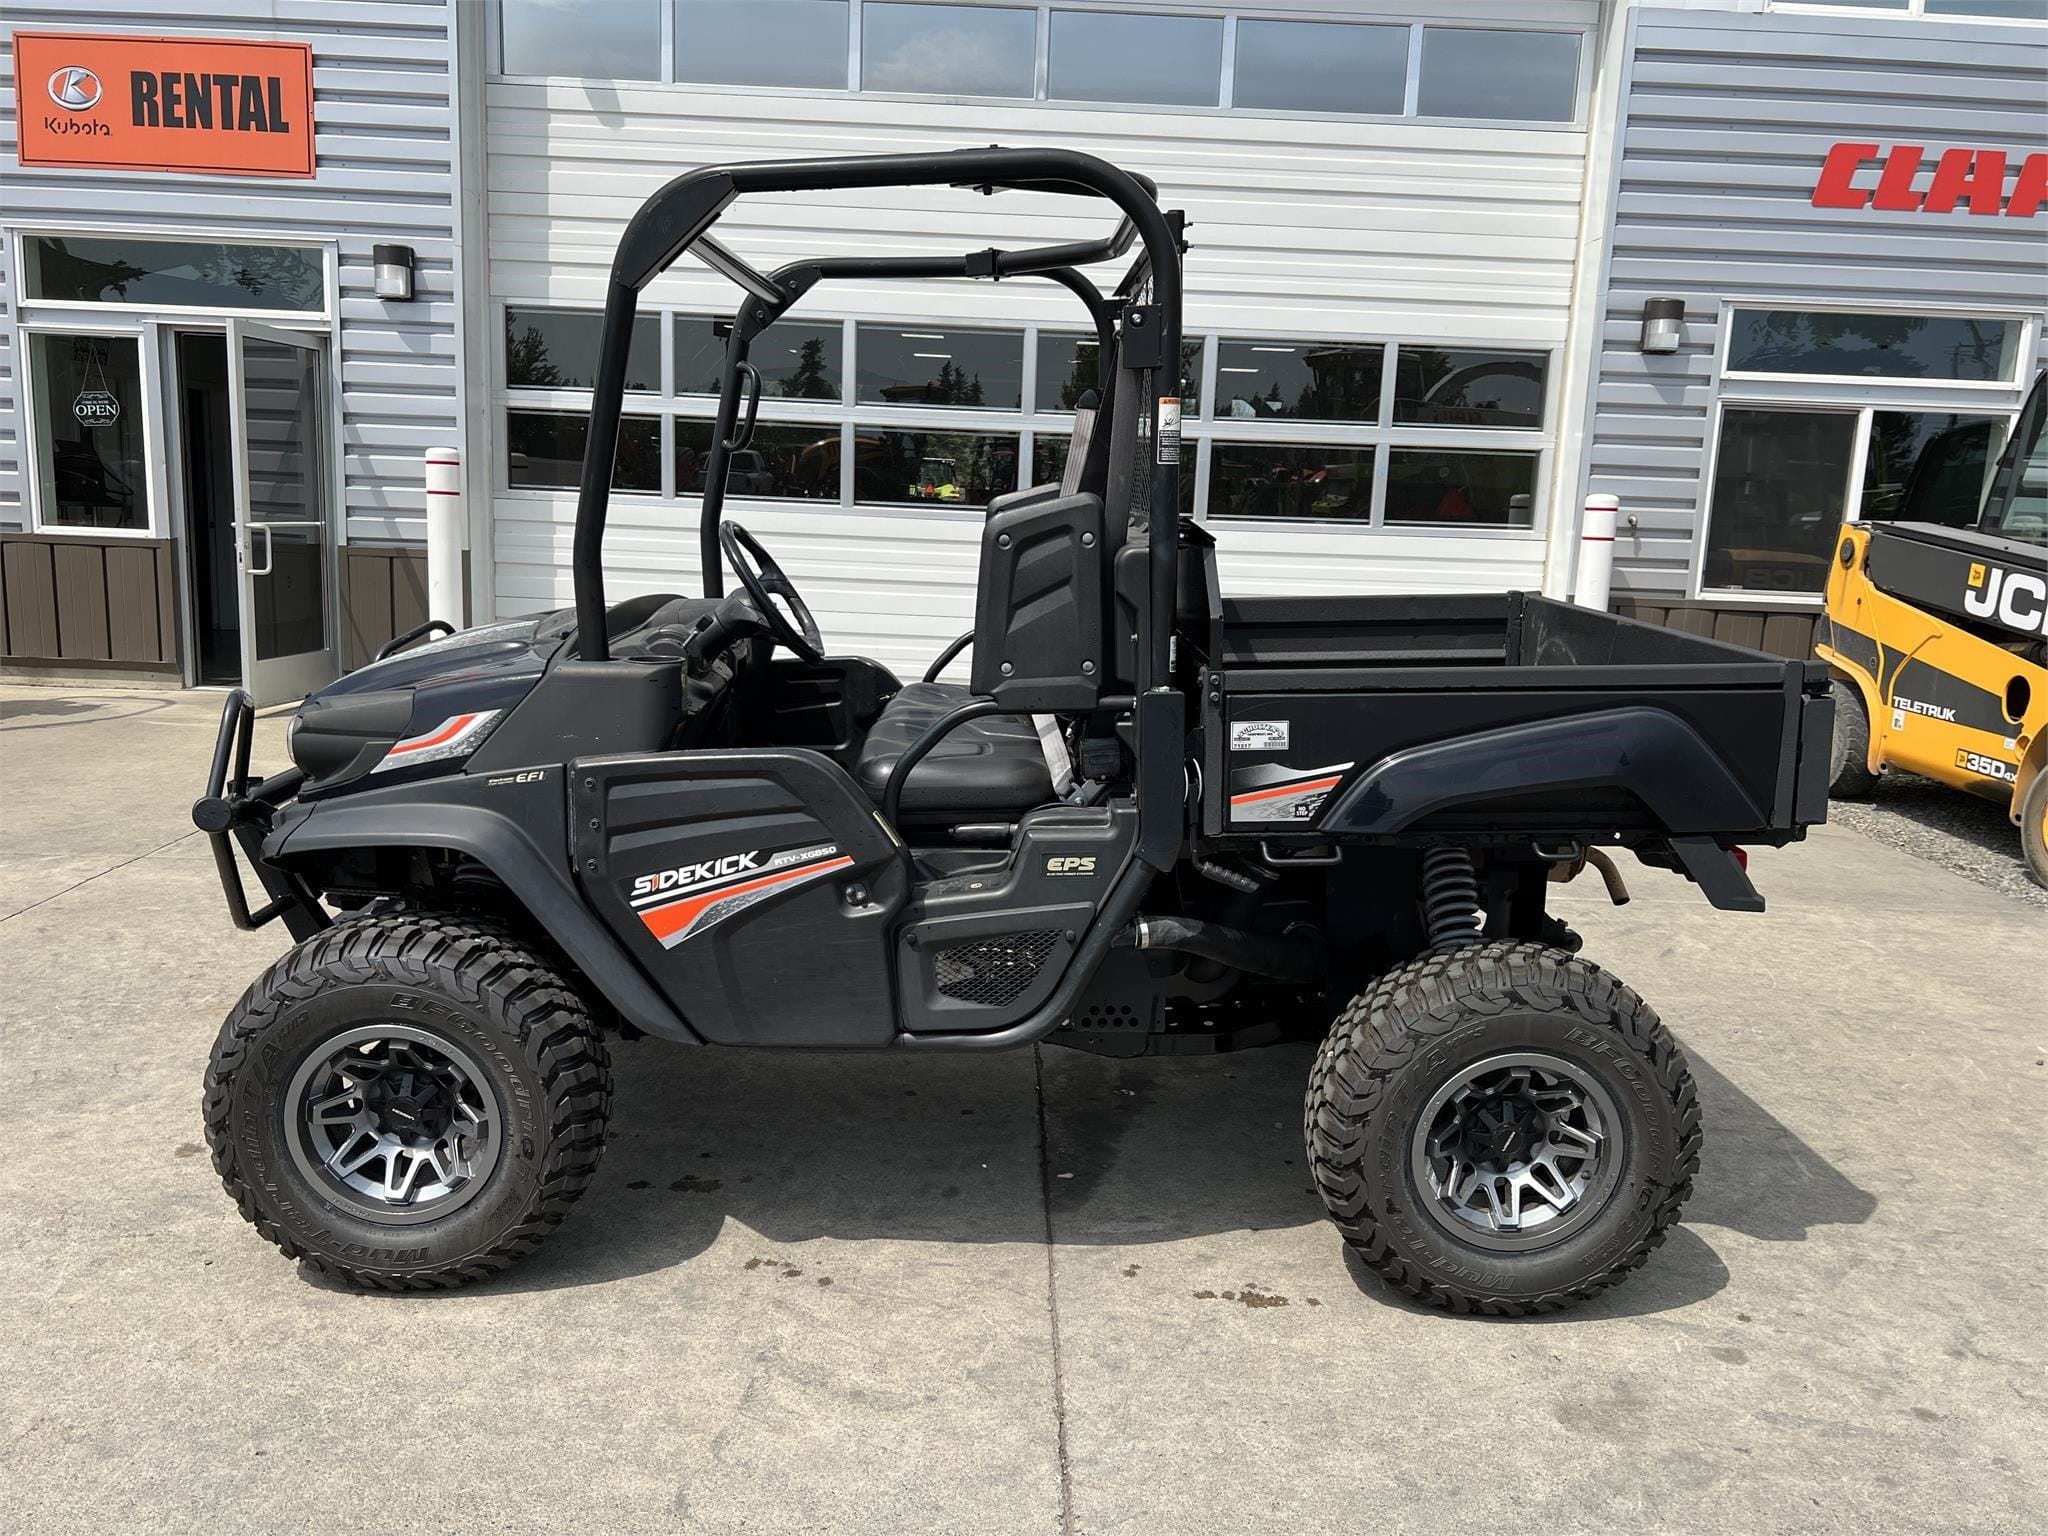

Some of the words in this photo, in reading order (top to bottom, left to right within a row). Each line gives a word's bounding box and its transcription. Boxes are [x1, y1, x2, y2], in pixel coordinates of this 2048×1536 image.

[130, 70, 289, 134] RENTAL
[44, 117, 111, 136] Kubota
[75, 404, 117, 415] OPEN
[1964, 567, 2048, 636] JC
[1893, 696, 1957, 722] TELETRUK
[516, 770, 544, 783] EFI
[1047, 857, 1096, 871] EPS
